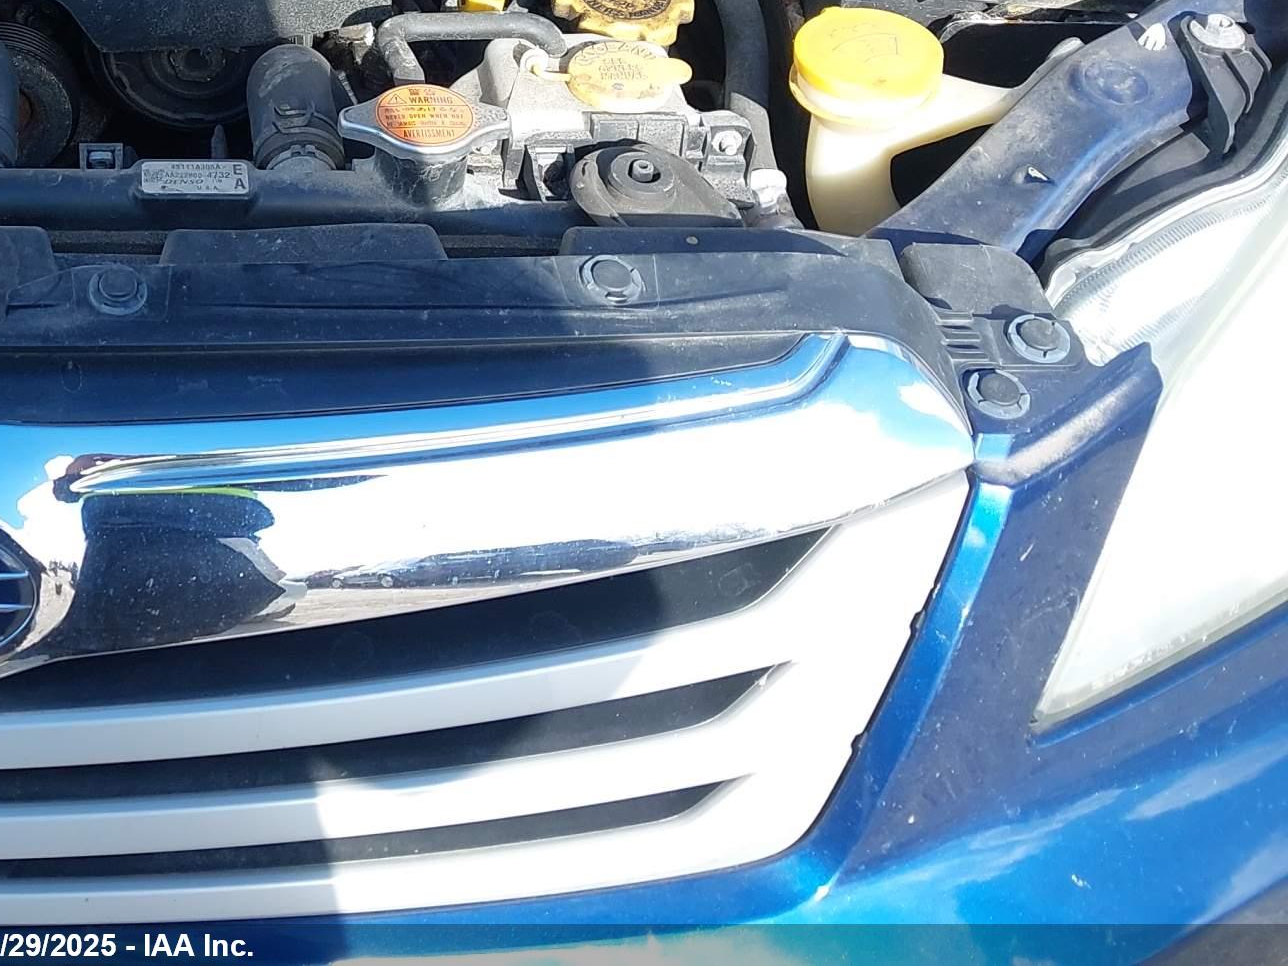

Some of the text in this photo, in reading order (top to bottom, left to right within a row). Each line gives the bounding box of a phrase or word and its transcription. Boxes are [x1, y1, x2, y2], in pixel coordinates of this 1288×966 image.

[409, 96, 453, 104] WARNING
[232, 164, 243, 175] E
[234, 177, 246, 189] A
